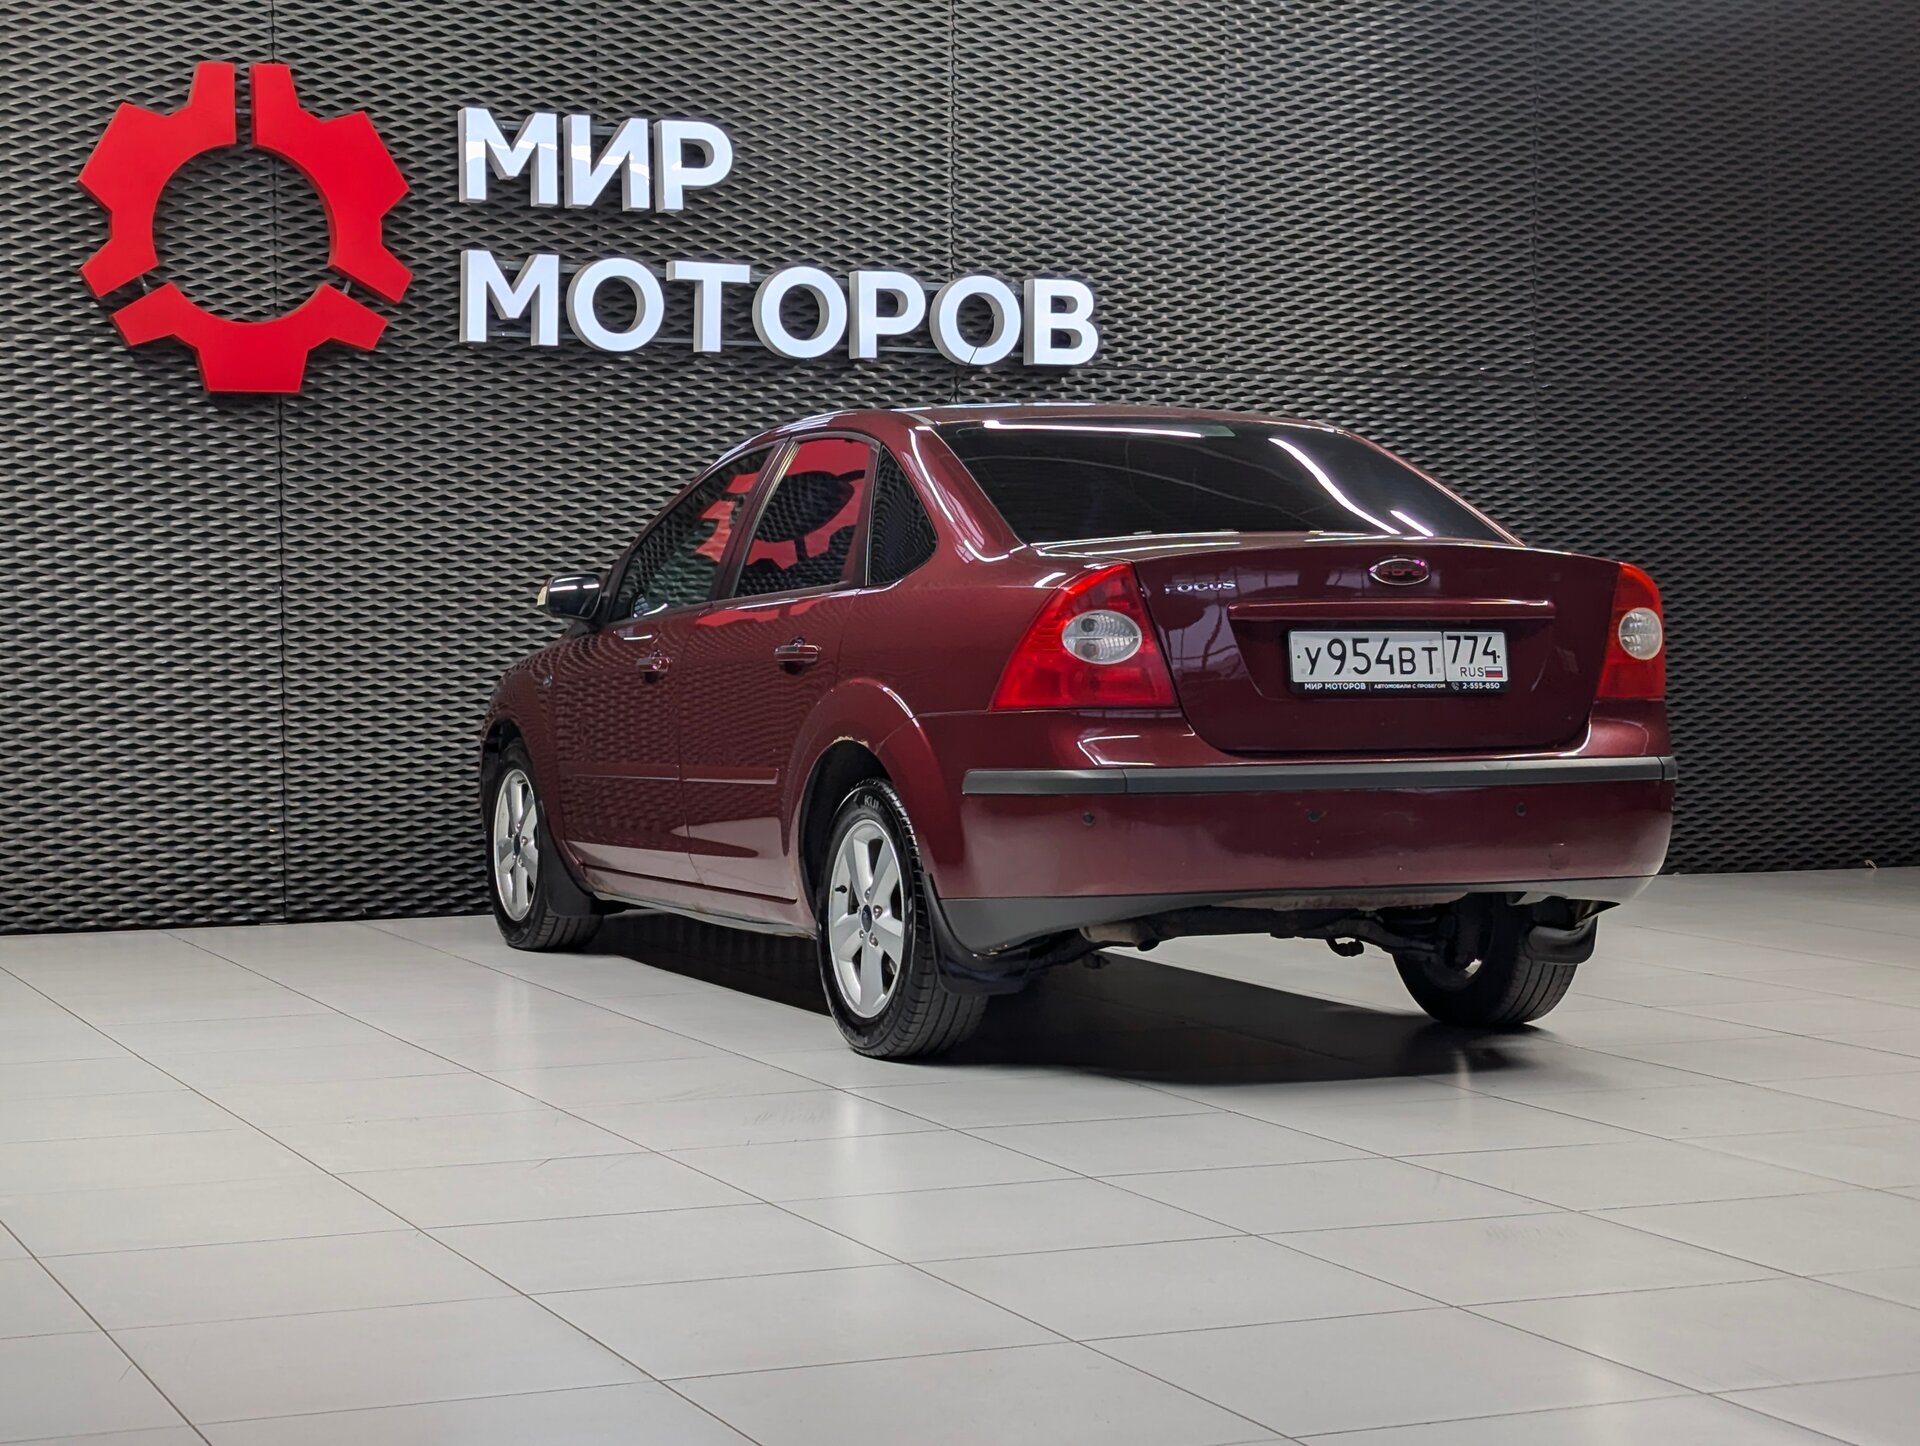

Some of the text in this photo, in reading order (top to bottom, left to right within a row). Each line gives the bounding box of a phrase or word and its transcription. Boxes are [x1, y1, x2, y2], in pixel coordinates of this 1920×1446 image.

[458, 106, 734, 213] МИР
[459, 249, 1100, 367] МОТОРОВ
[1304, 635, 1498, 676] У954ВТ 774
[1459, 666, 1485, 678] RUS
[1304, 682, 1367, 691] МИР МОТОРОВ
[1462, 682, 1500, 690] 2-555-850
